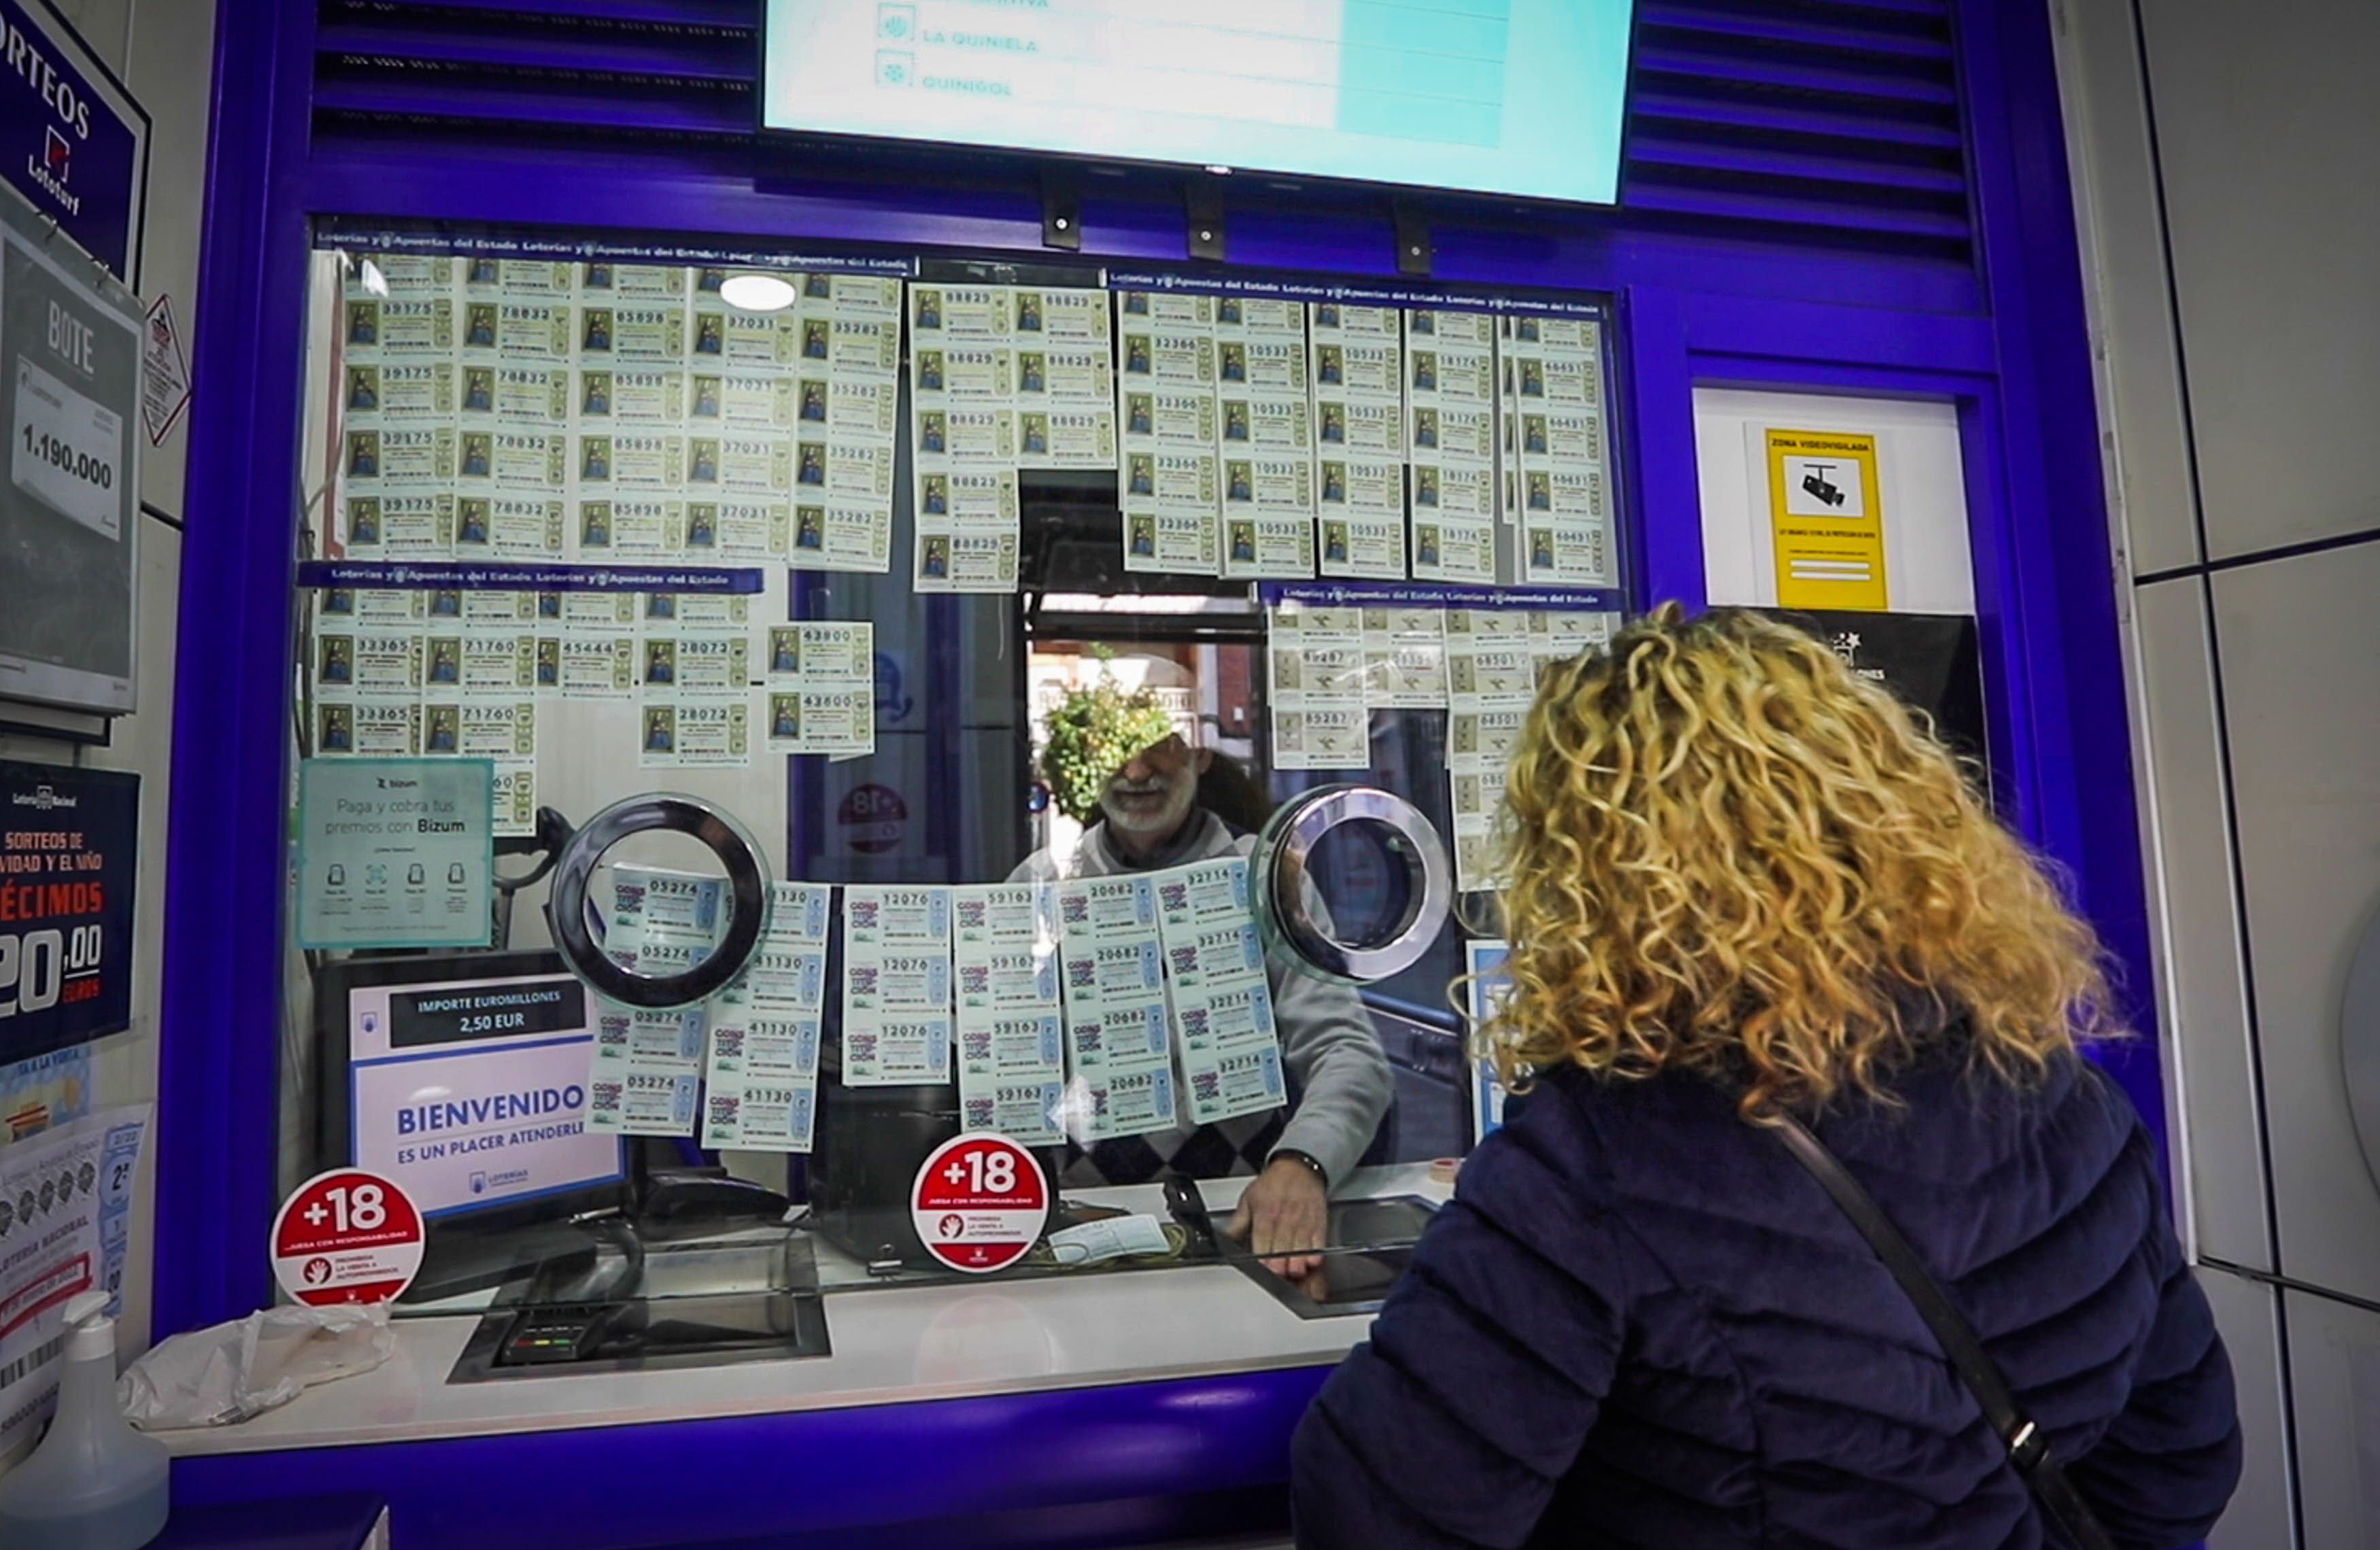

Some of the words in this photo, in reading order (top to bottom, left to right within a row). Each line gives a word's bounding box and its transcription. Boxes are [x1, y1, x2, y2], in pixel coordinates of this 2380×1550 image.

[454, 238, 473, 248] del
[477, 239, 517, 250] Estado
[1225, 280, 1242, 290] del
[48, 300, 95, 375] BOTE
[1771, 438, 1797, 449] ZONA
[1800, 439, 1869, 453] VIDEOVIGILADA
[23, 423, 112, 489] 1.190.000
[408, 570, 466, 583] Apuestas
[609, 573, 664, 585] Apuestas
[667, 574, 686, 585] del
[337, 798, 373, 815] Paga
[377, 802, 386, 815] y
[390, 797, 428, 812] cobra
[434, 798, 455, 812] tus
[326, 821, 383, 836] premios
[387, 822, 412, 833] con
[418, 818, 465, 833] Bizum
[5, 831, 67, 850] SORTEOS
[69, 832, 83, 849] DE
[45, 854, 56, 872] Y
[59, 854, 73, 871] EL
[76, 850, 103, 871] NIÑO
[1189, 868, 1229, 885] 32714
[649, 880, 698, 895] 05274
[884, 892, 928, 906] 12076
[1199, 930, 1240, 948] 32714
[642, 946, 690, 959] 05274
[755, 956, 802, 969] 41130
[884, 958, 928, 970] 12076
[63, 978, 101, 1003] EUROS
[418, 997, 471, 1014] IMPORTE
[475, 991, 561, 1009] EUROMILLONES
[1210, 993, 1251, 1010] 32714
[460, 1016, 493, 1033] 2,50
[495, 1013, 525, 1028] EUR
[634, 1010, 683, 1024] 05274
[749, 1022, 797, 1036] 41130
[883, 1024, 928, 1037] 12076
[1220, 1054, 1260, 1073] 32714
[627, 1075, 675, 1089] 05274
[744, 1090, 792, 1104] 41130
[397, 1084, 584, 1135] BIENVENIDO
[398, 1150, 415, 1165] ES
[421, 1144, 445, 1160] UN
[450, 1135, 505, 1156] PLACER
[943, 1150, 1017, 1194] +18
[304, 1184, 386, 1233] +18
